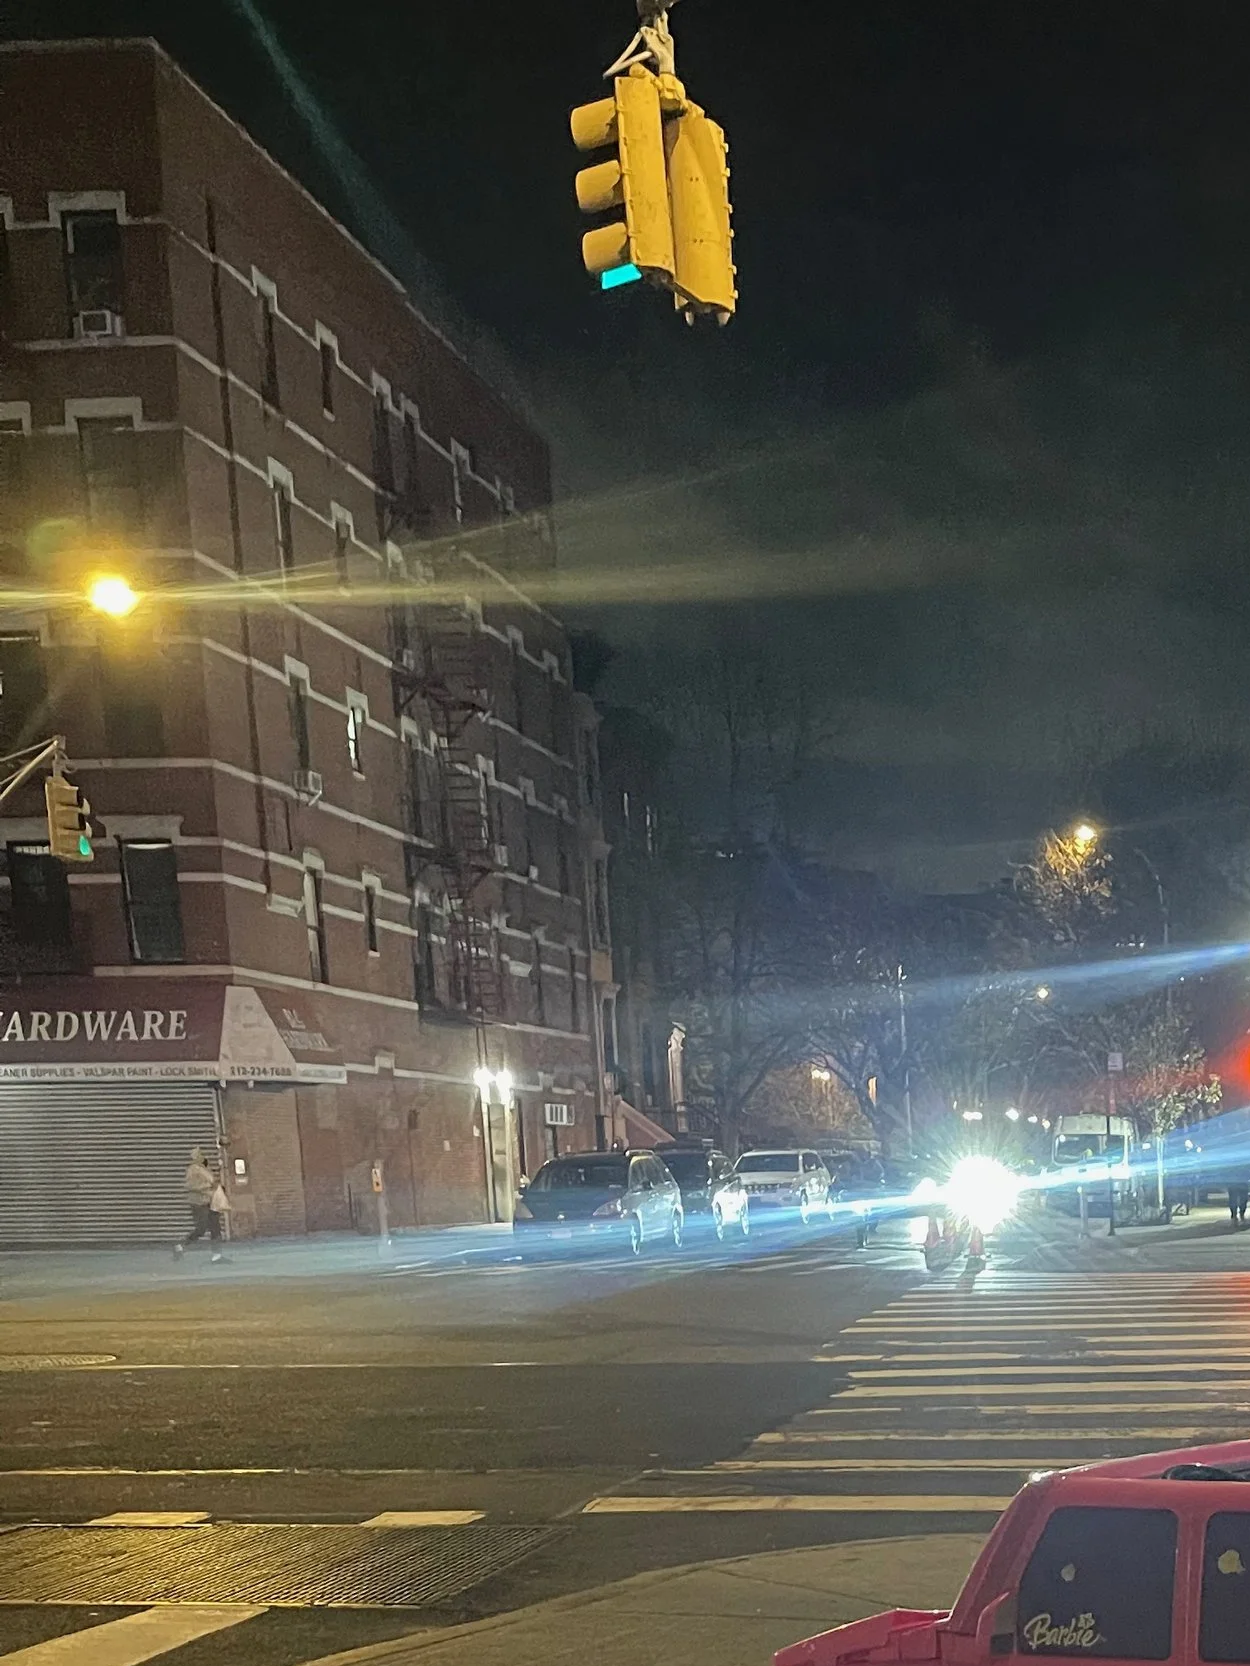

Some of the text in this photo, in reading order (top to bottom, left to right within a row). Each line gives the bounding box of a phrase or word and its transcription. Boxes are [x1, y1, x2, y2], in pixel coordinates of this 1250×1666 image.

[0, 1010, 187, 1042] ARDWARE
[160, 1066, 186, 1077] LOCK
[1023, 1612, 1103, 1650] Barbie
